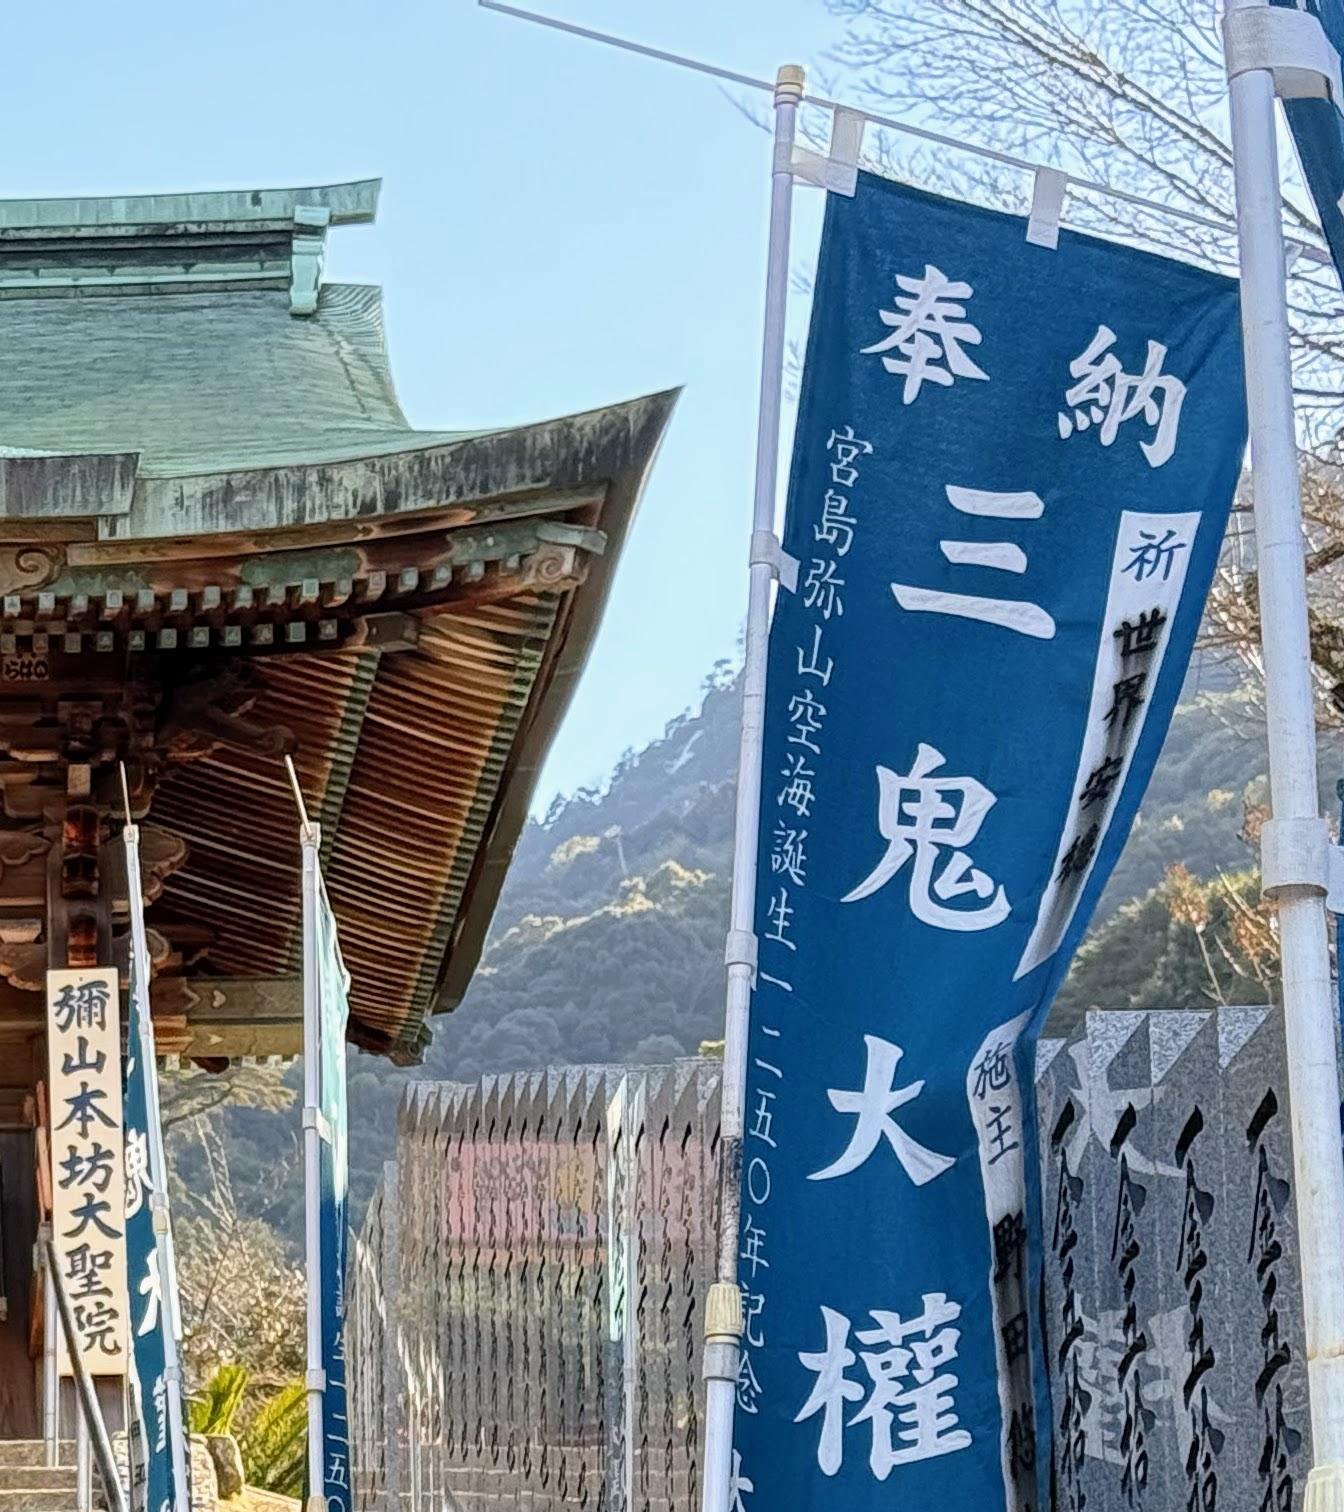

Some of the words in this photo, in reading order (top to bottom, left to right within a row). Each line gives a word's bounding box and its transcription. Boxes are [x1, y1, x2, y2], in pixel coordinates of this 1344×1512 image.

[861, 264, 1189, 468] 奉納
[1121, 529, 1187, 582] 祈
[53, 980, 124, 1356] 彌山本坊大聖院
[972, 1041, 1019, 1166] 施主
